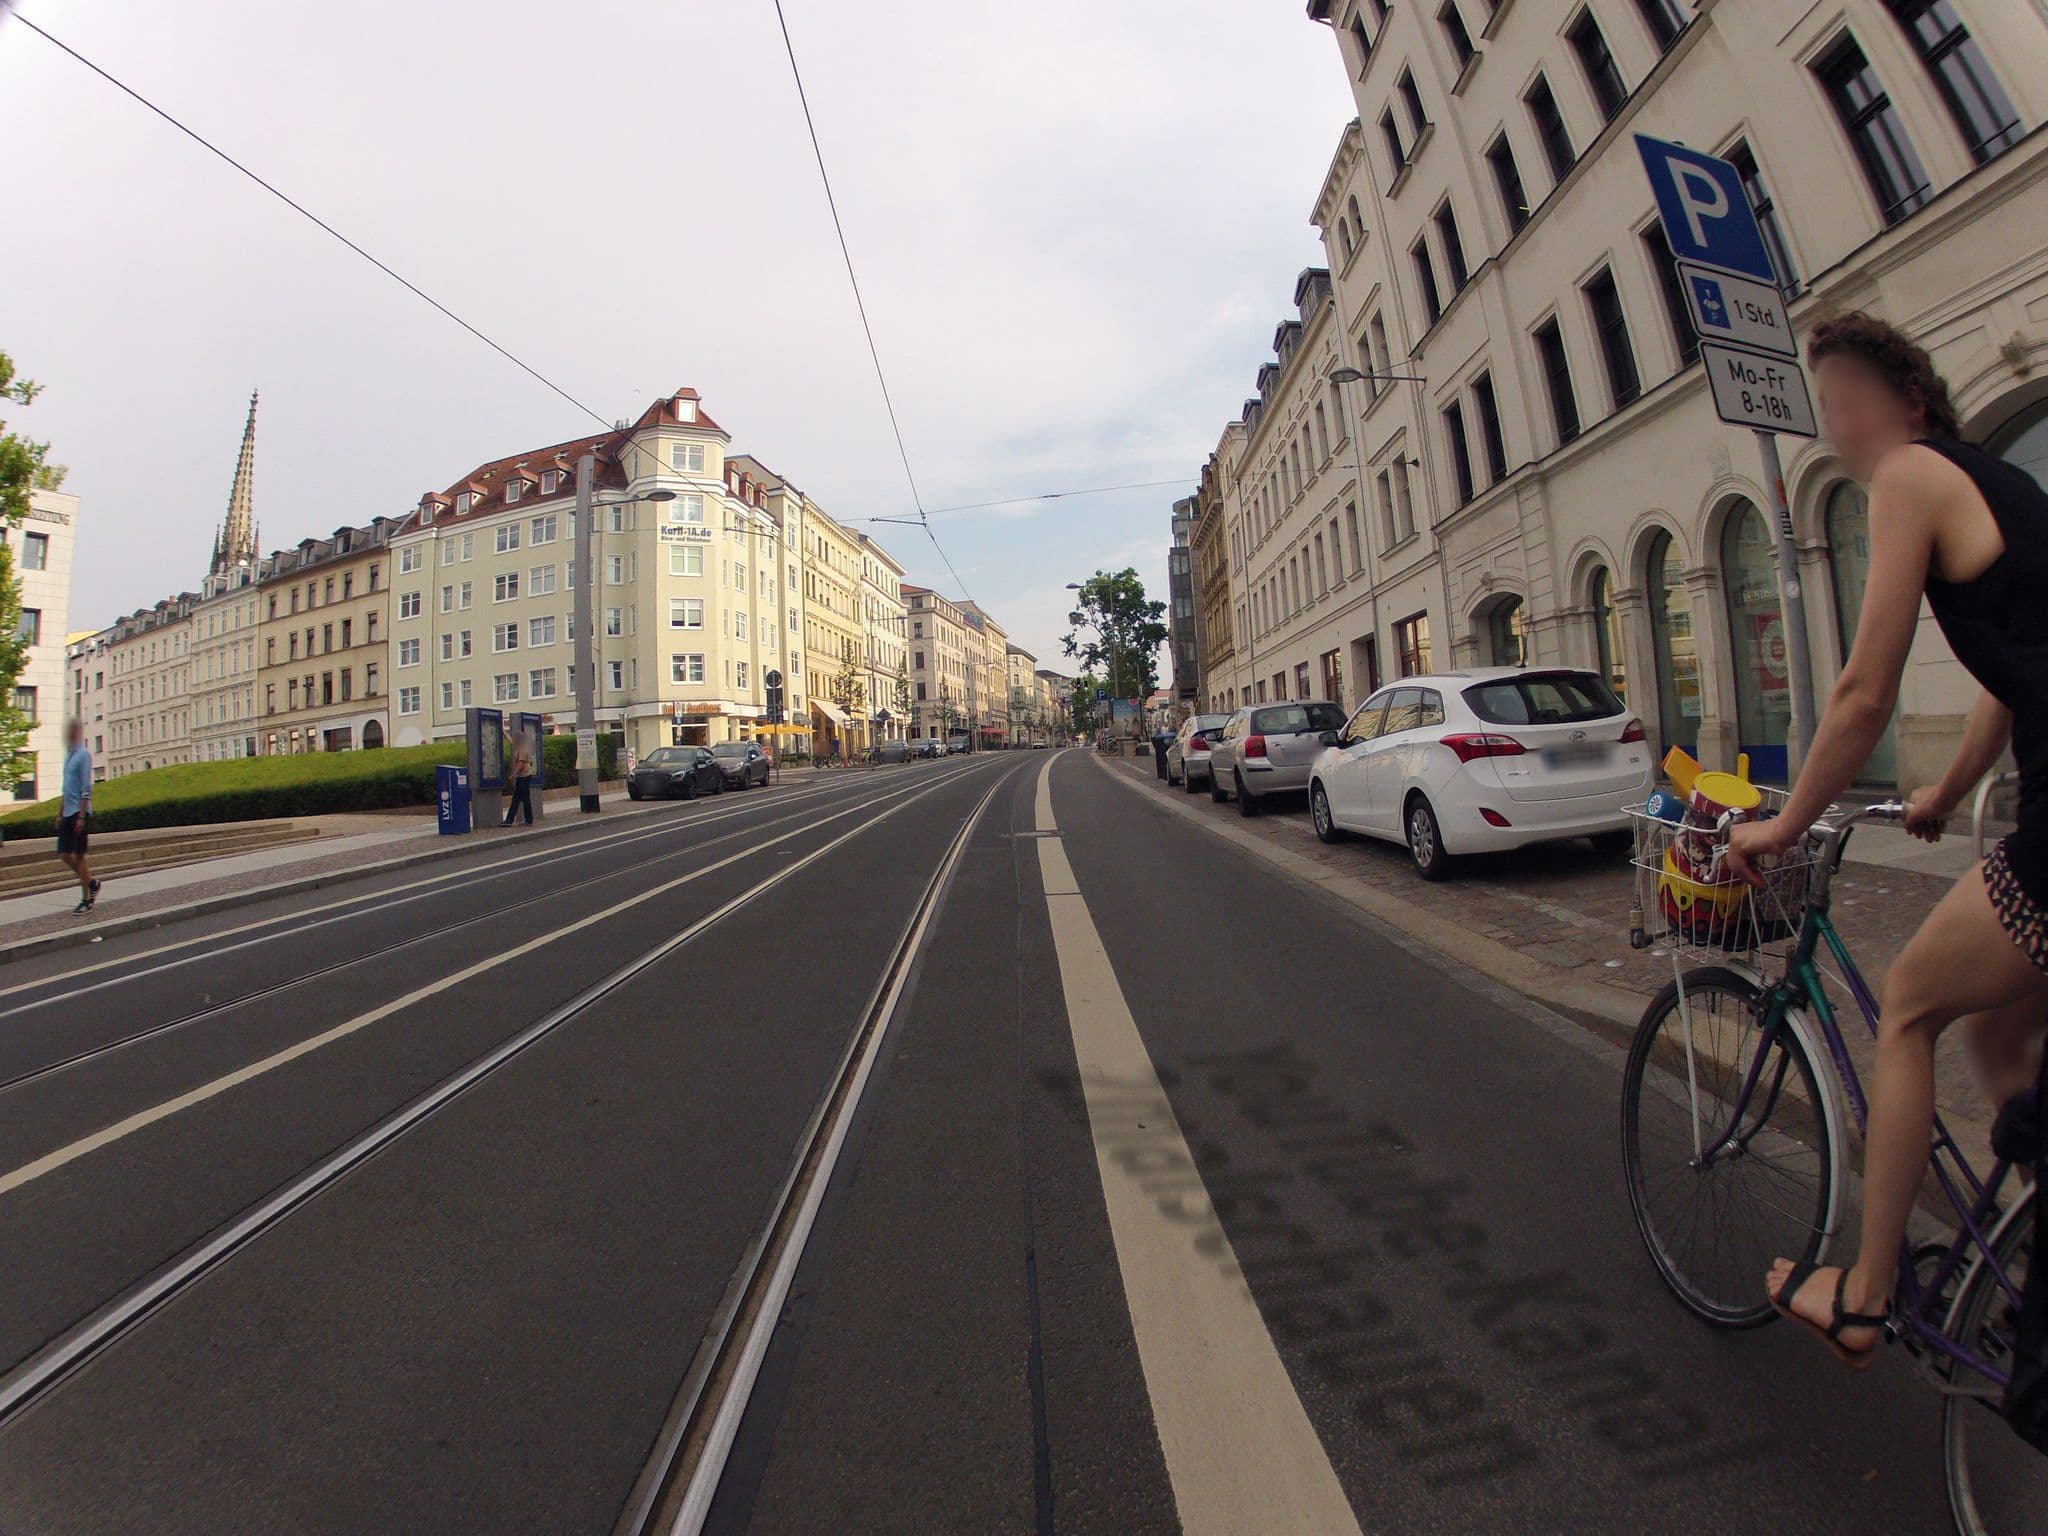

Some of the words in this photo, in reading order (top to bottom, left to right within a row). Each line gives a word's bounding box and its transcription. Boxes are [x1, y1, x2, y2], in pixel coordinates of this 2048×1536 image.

[1665, 156, 1729, 248] P
[1734, 300, 1743, 319] 1
[1745, 303, 1780, 328] Std.
[1728, 359, 1785, 391] Mo-Fr
[1741, 391, 1792, 420] 8-18h
[442, 801, 450, 820] LVZ
